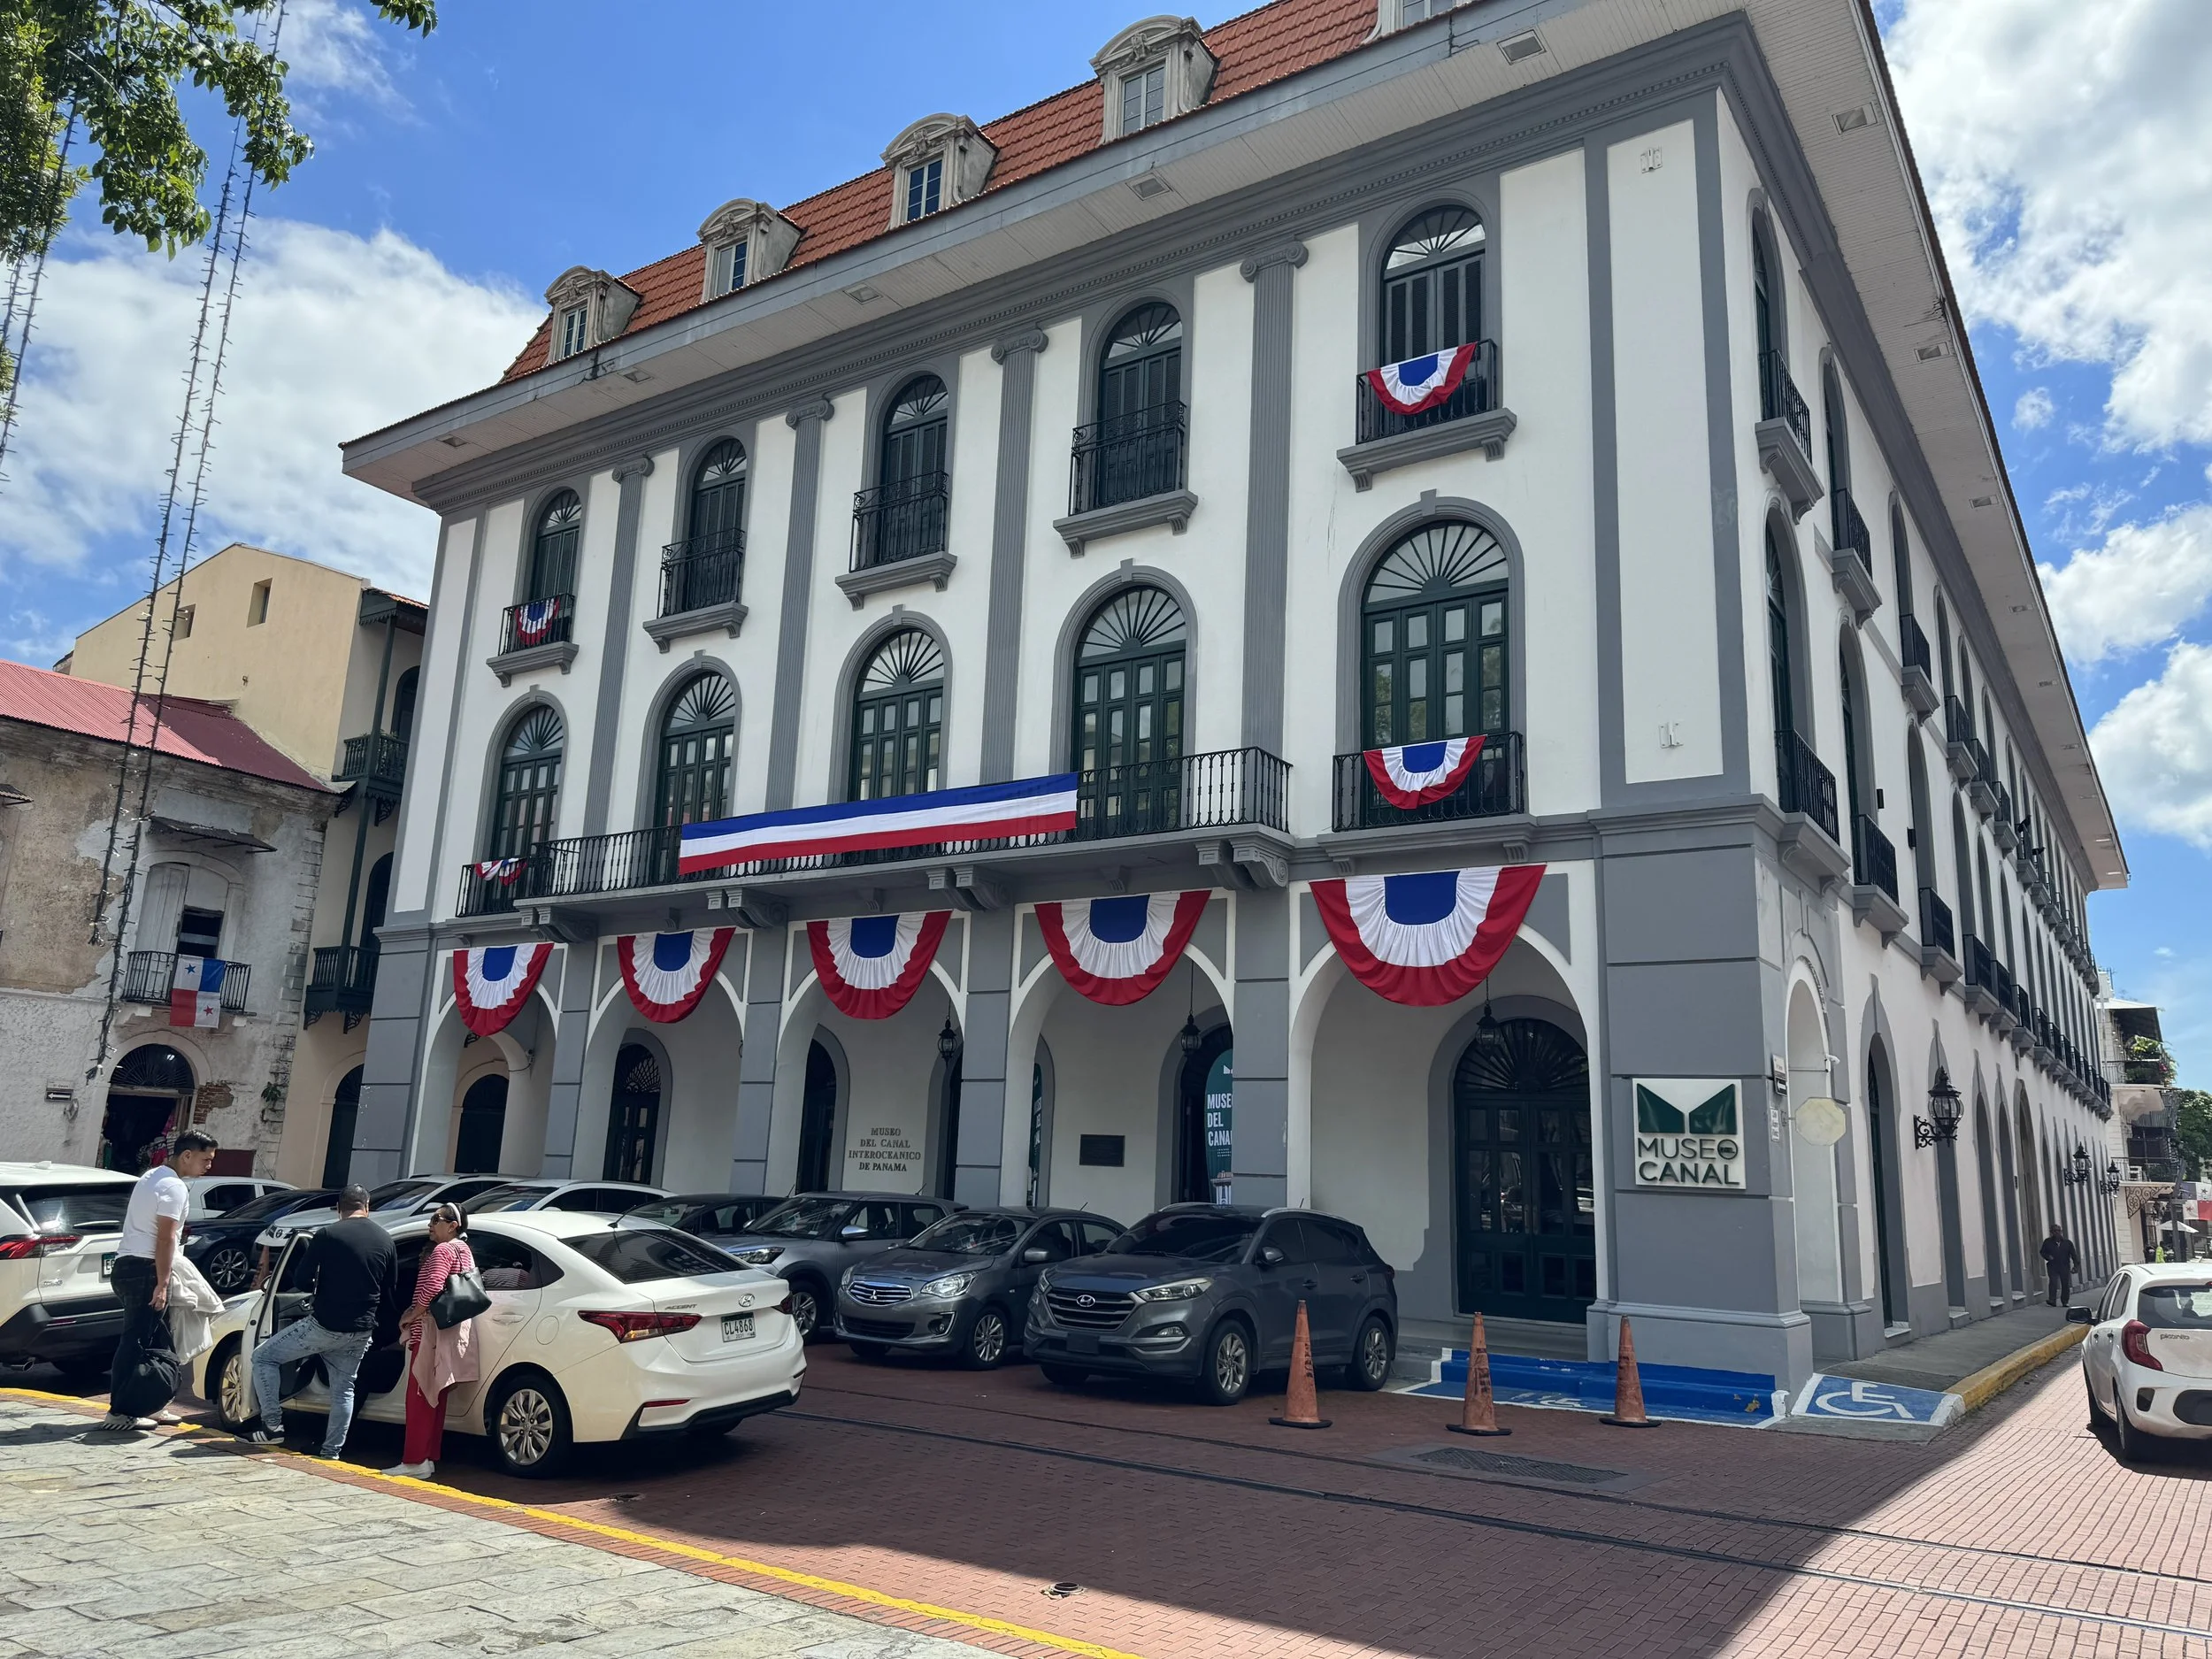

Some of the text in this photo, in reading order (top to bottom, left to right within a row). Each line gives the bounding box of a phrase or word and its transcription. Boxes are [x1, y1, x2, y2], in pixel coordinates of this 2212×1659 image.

[1207, 1093, 1233, 1109] MUSE
[1207, 1112, 1224, 1128] DEL
[871, 1127, 901, 1136] MUSEO
[860, 1139, 910, 1148] DEL CANAL
[1638, 1137, 1739, 1160] MUSEO
[849, 1150, 921, 1161] INTEROCEANICO
[858, 1162, 907, 1172] DE PANAMA
[1639, 1161, 1740, 1185] CANAL
[724, 1318, 753, 1335] CL4868
